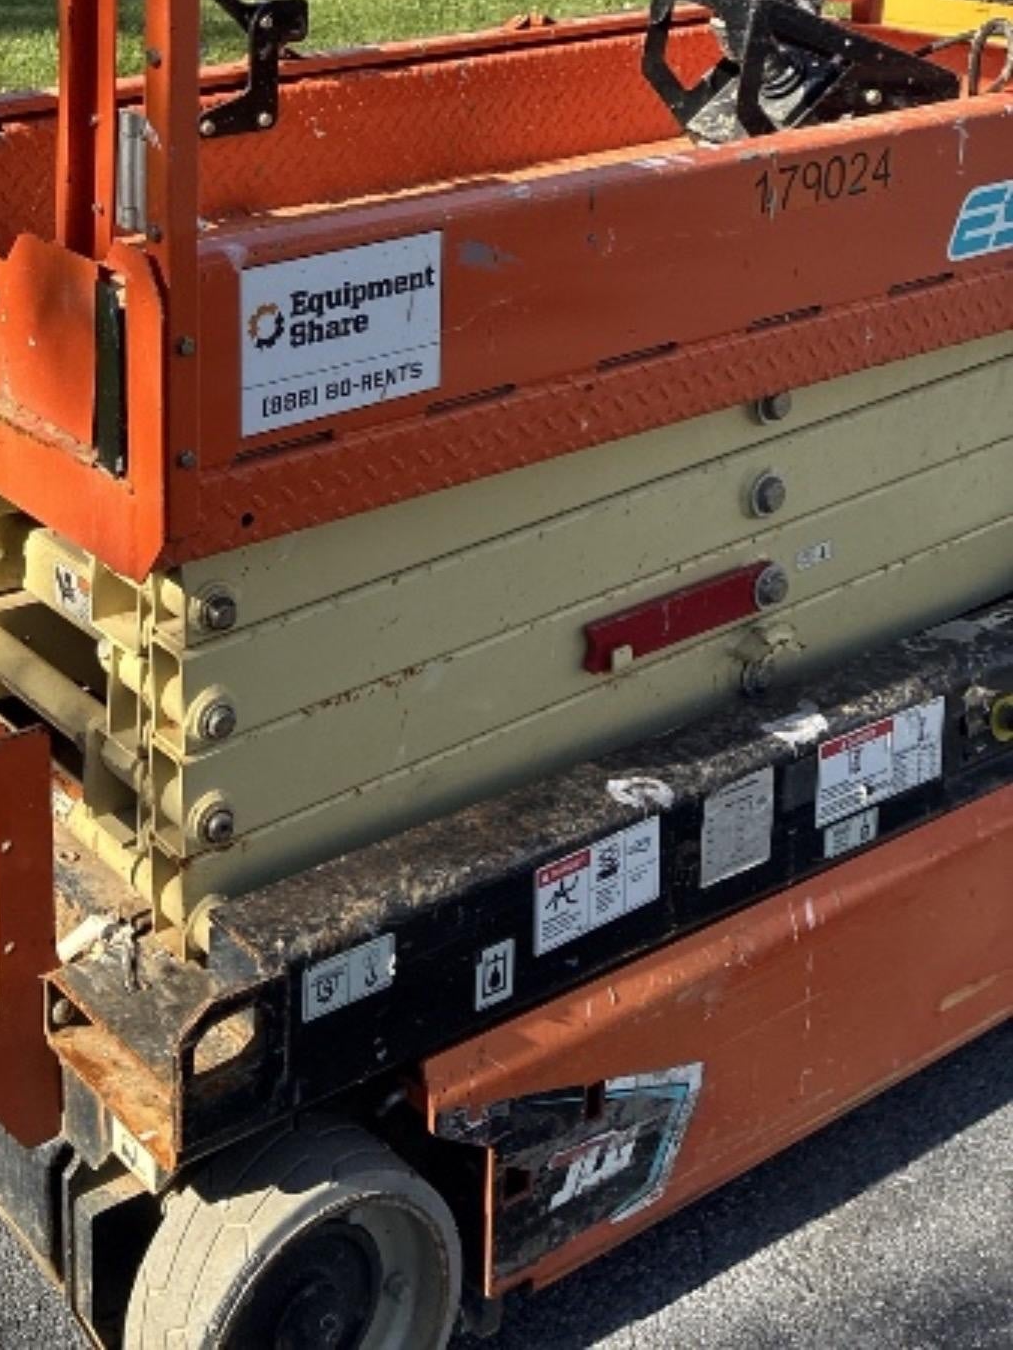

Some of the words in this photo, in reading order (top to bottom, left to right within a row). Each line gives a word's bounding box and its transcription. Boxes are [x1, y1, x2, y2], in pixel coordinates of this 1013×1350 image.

[755, 147, 892, 214] 179024
[289, 265, 435, 318] Equipment
[289, 313, 369, 349] Share
[325, 361, 424, 401] 80-RENTS
